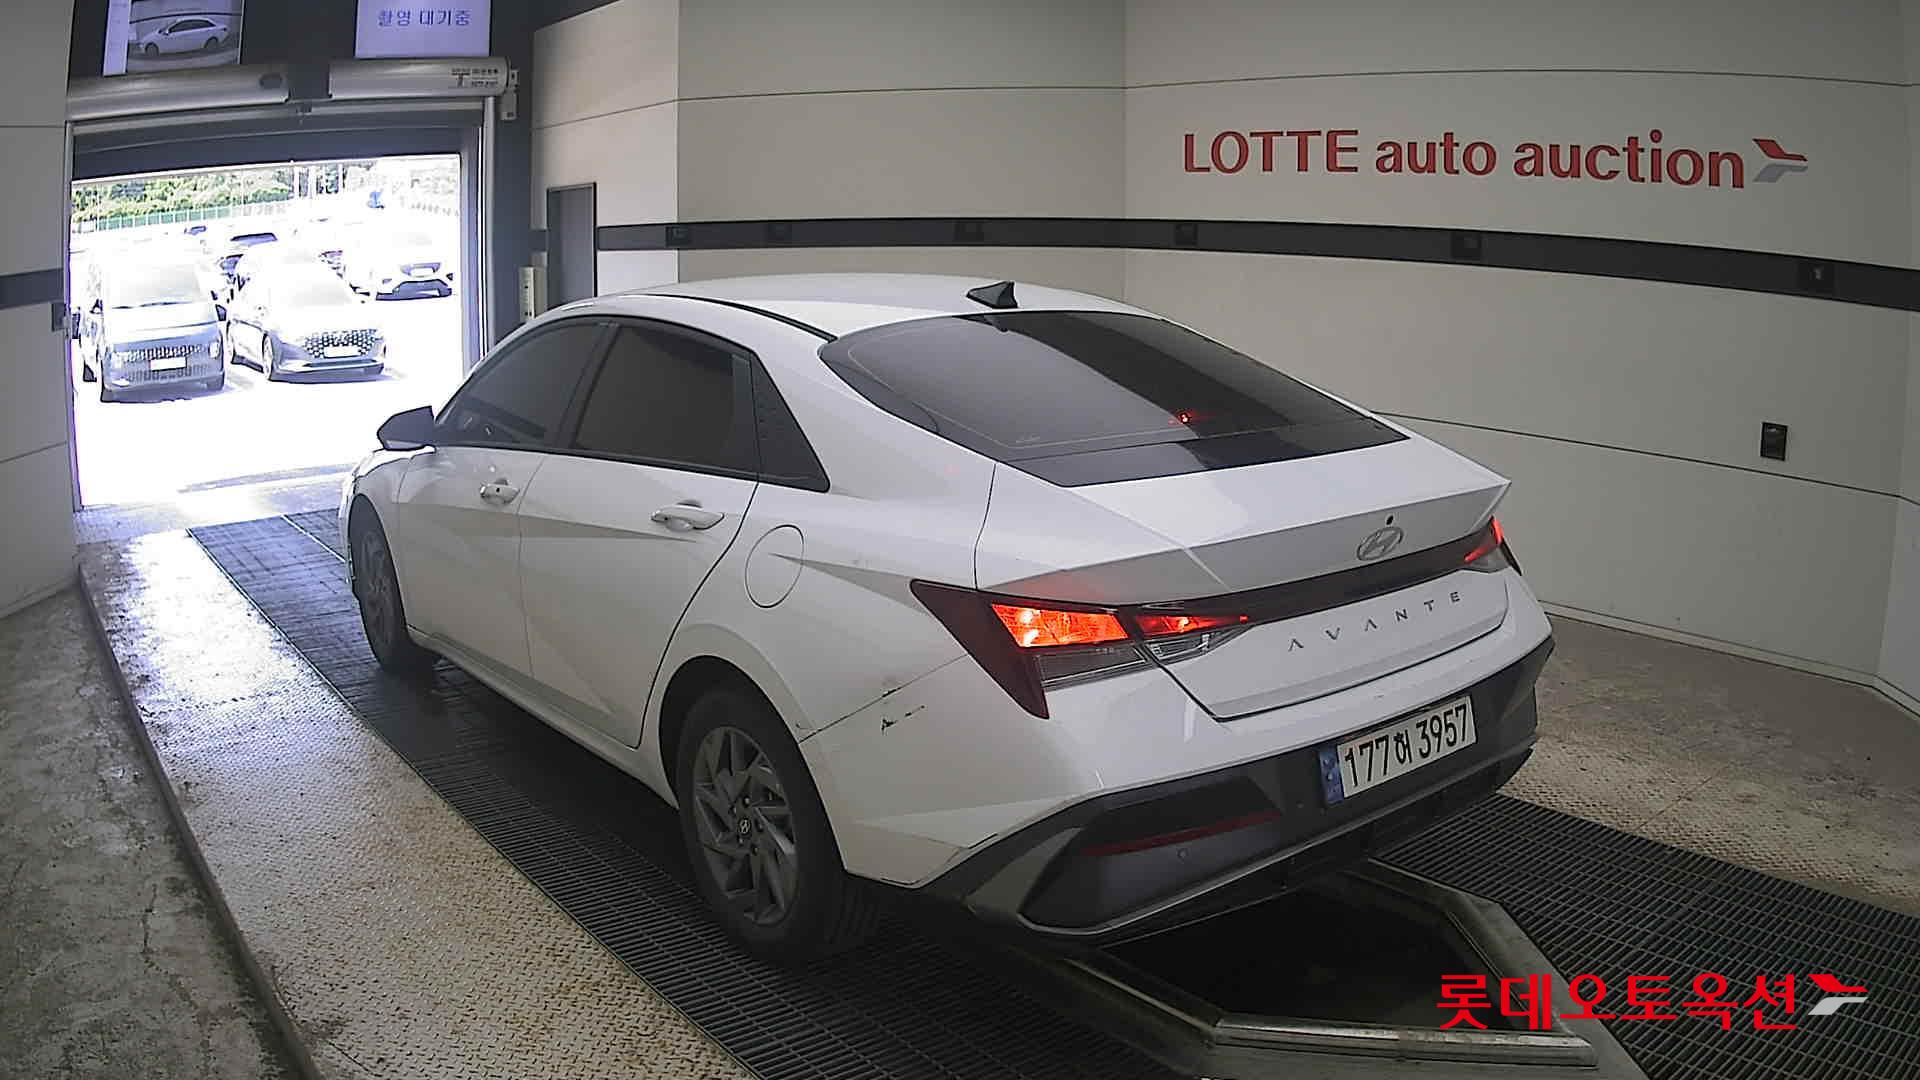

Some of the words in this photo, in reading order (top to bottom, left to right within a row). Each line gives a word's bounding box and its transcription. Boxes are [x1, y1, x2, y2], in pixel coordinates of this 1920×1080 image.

[418, 8, 472, 27] 대기중
[1183, 130, 1359, 174] LOTTE
[1375, 131, 1497, 176] auto
[1512, 129, 1746, 189] auction
[1287, 591, 1462, 652] AVANTE
